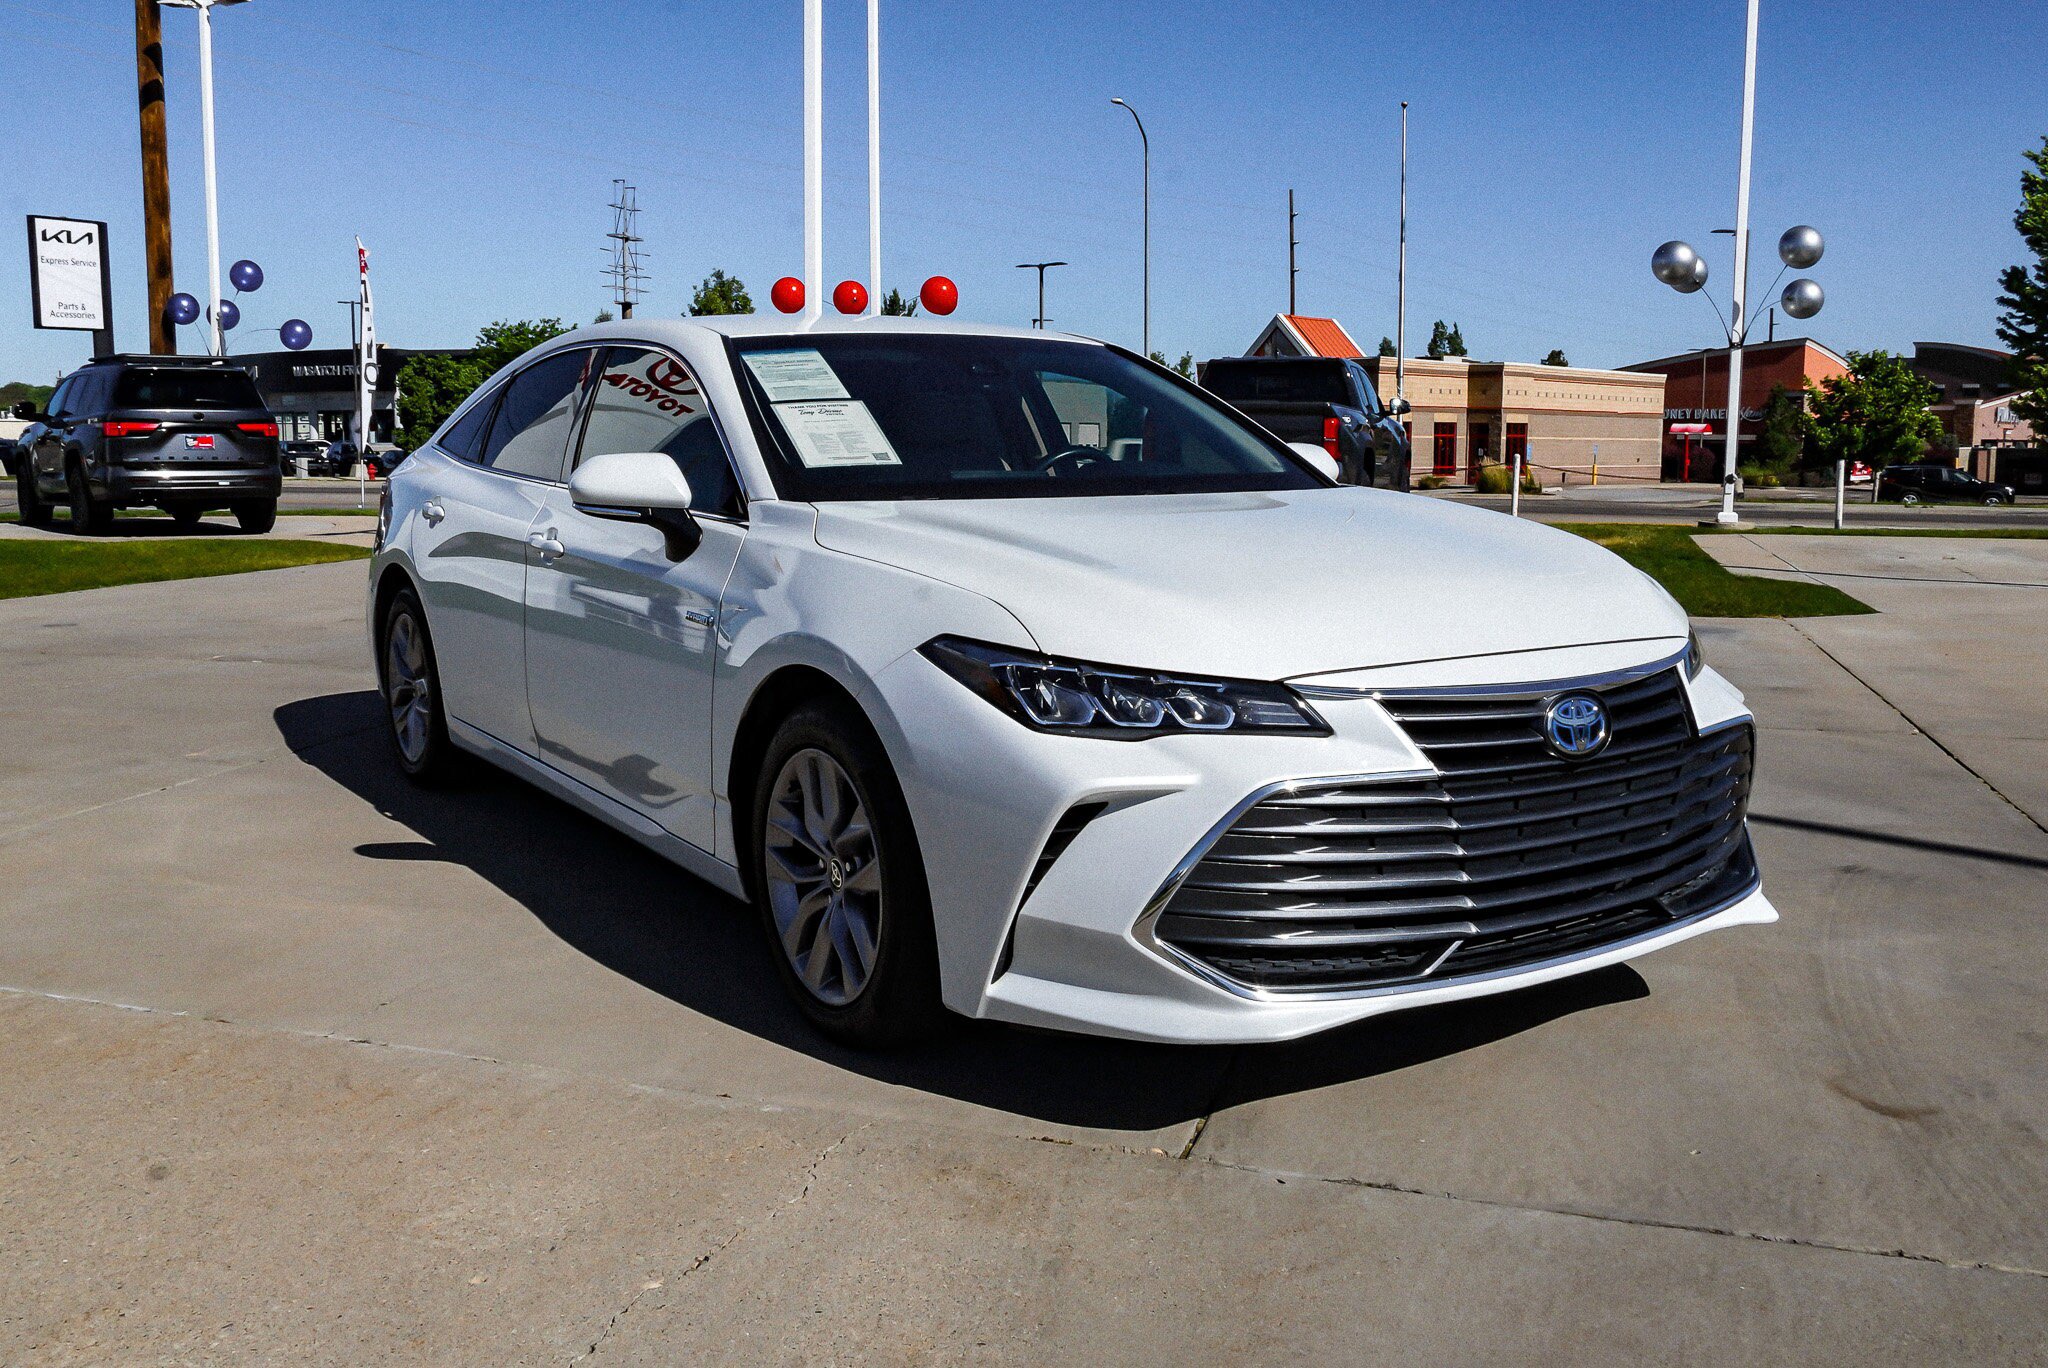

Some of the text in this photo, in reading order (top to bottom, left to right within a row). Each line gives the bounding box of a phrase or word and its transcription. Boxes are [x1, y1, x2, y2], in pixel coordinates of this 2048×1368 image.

[41, 229, 93, 245] KIA
[40, 255, 97, 268] Express Service
[58, 301, 86, 311] Parts &
[50, 310, 96, 320] Accessories
[292, 365, 340, 377] WASATCH
[1663, 408, 1692, 420] ONEY
[1694, 408, 1729, 420] BAKE
